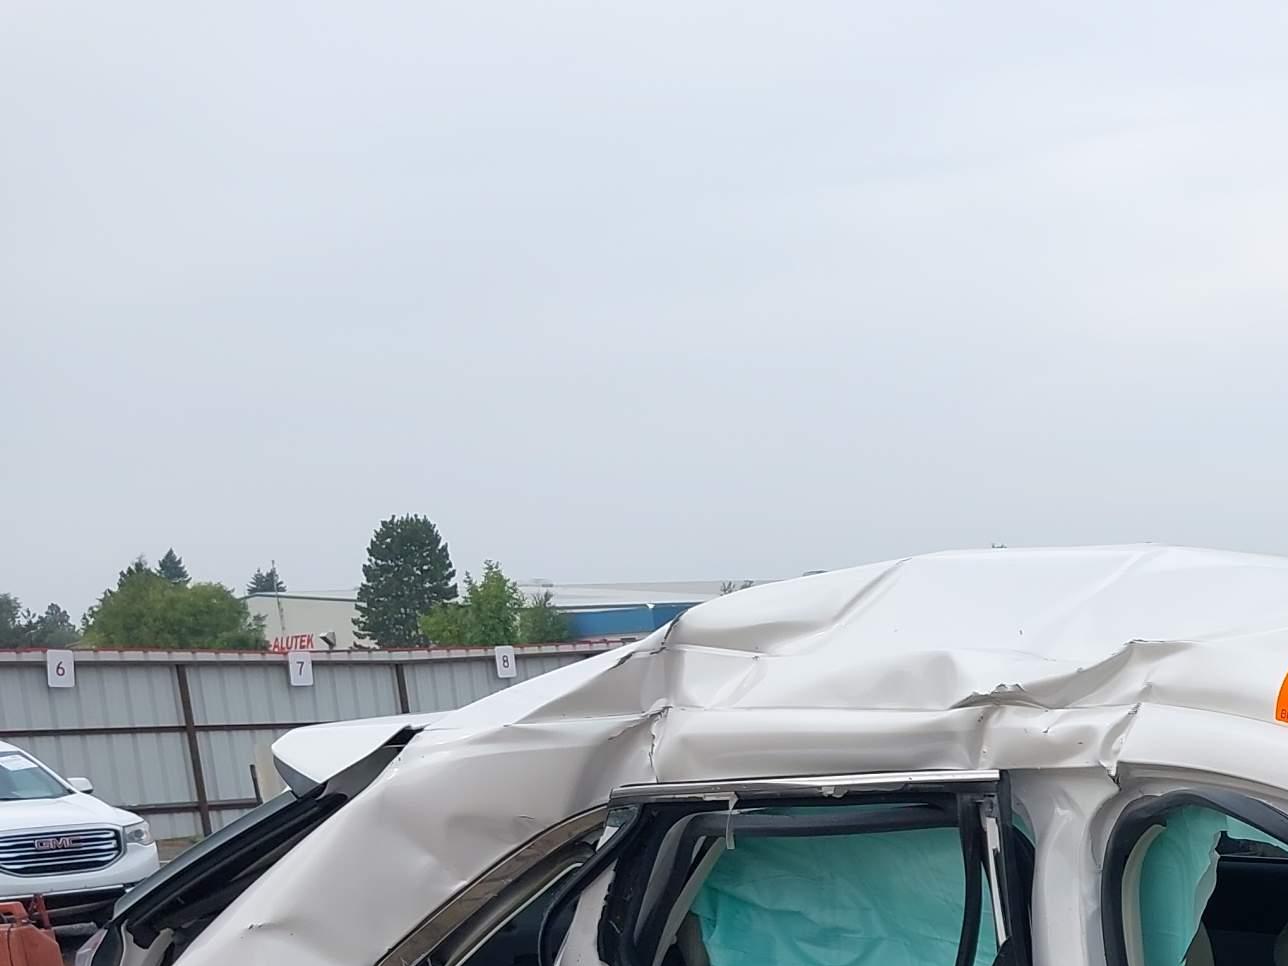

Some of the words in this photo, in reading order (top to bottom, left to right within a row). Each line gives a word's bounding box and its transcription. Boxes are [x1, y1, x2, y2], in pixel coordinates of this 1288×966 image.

[55, 660, 66, 677] 6
[296, 661, 305, 676] 7
[502, 654, 510, 669] 8
[34, 836, 82, 851] GMC
